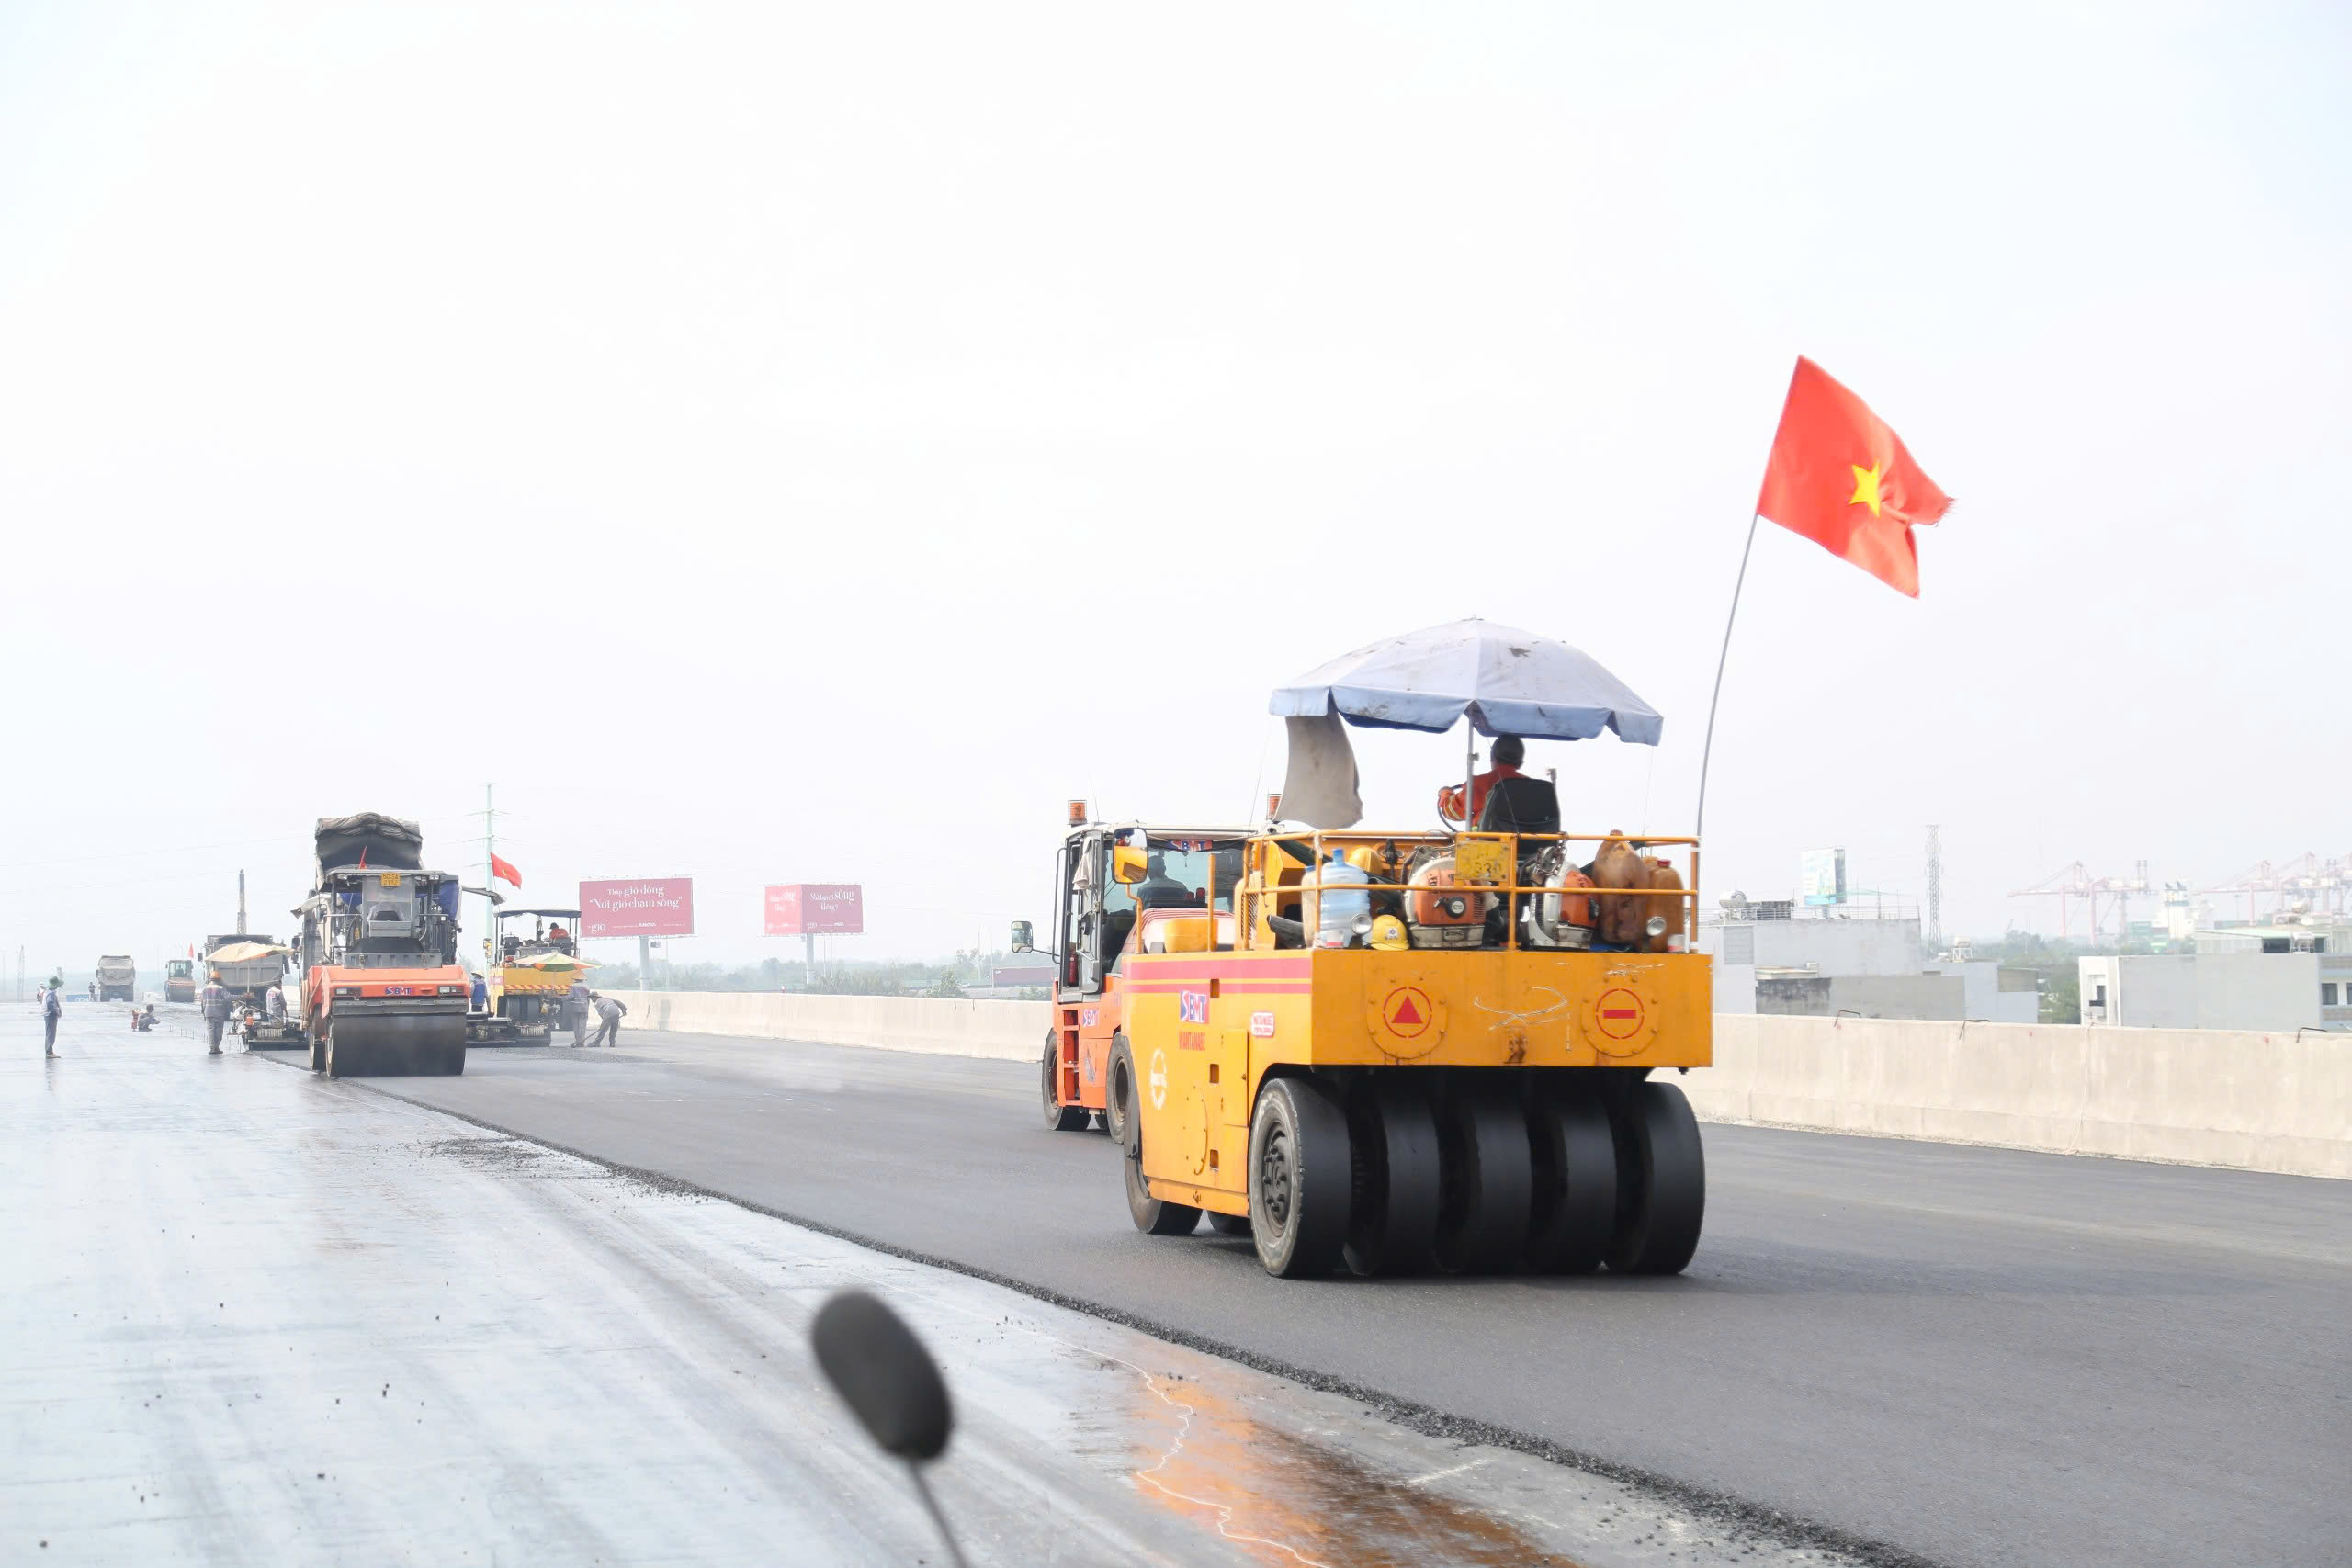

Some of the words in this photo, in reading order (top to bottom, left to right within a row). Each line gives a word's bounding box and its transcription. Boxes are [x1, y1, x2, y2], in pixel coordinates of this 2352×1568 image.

[1169, 839, 1207, 852] SBMT
[385, 987, 412, 996] SBMT
[1179, 990, 1207, 1023] SBMT
